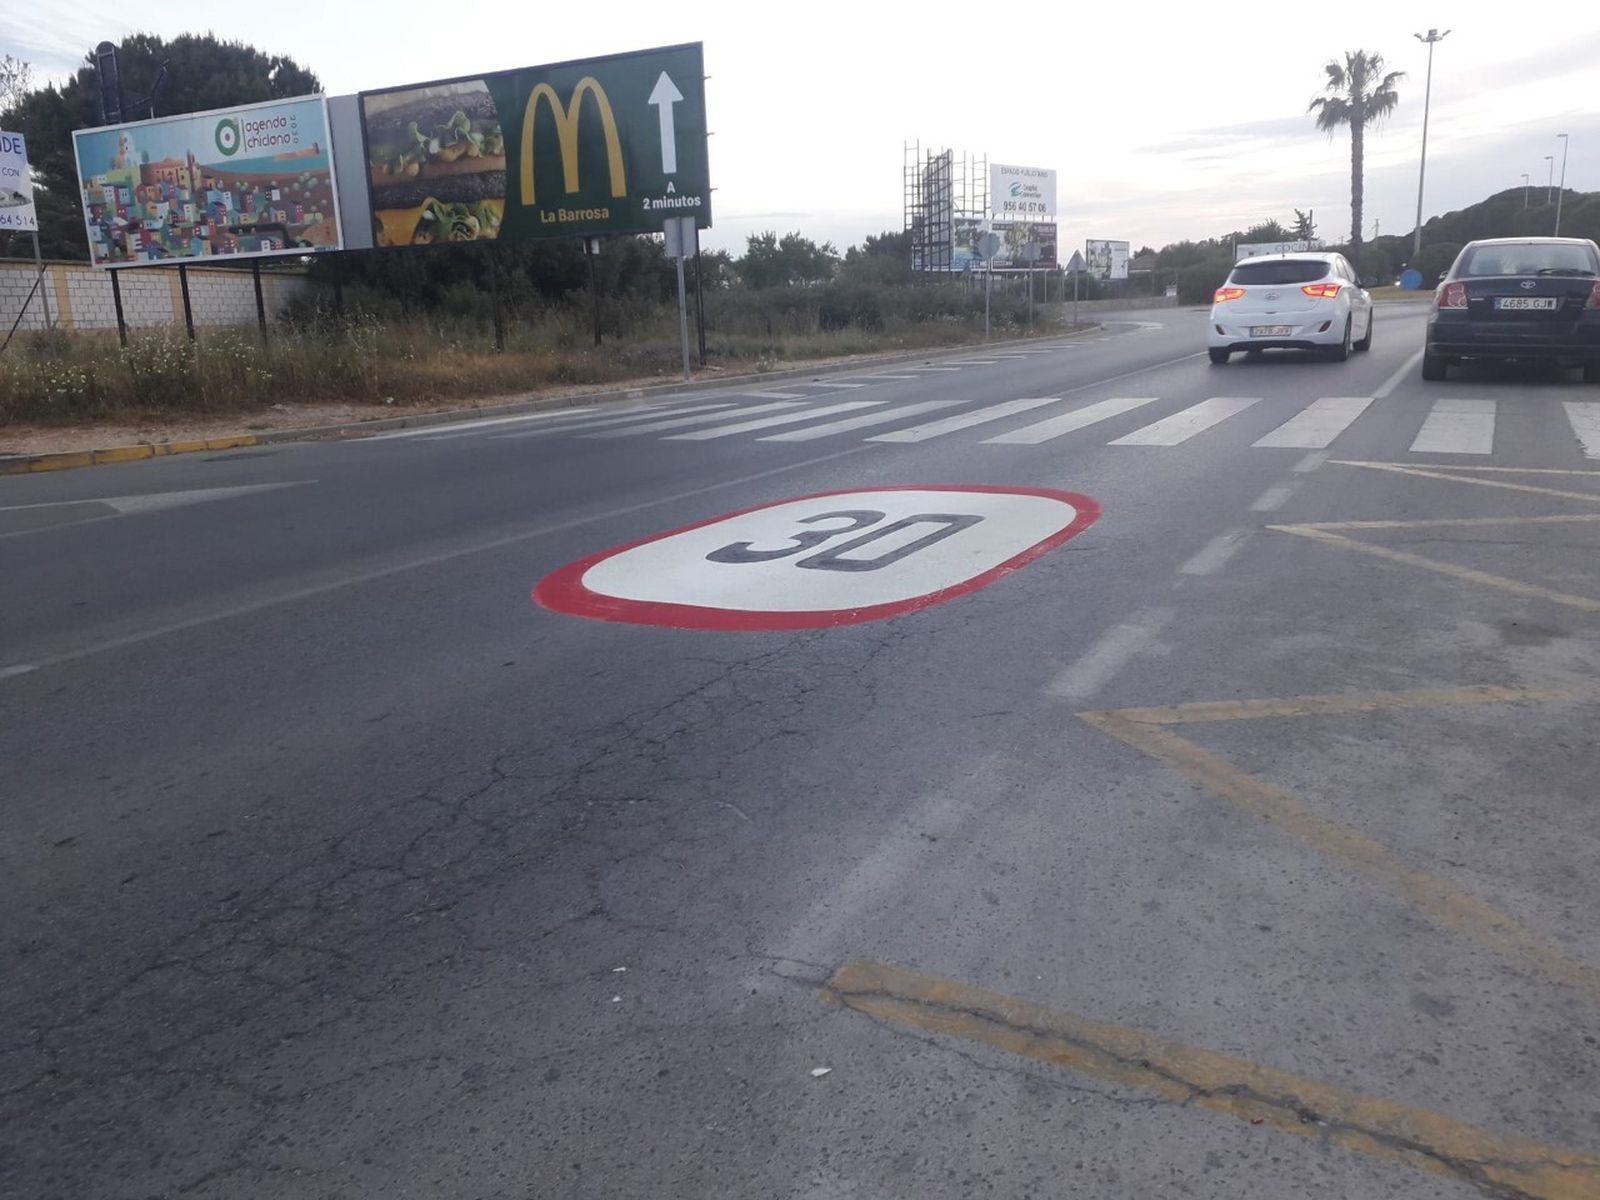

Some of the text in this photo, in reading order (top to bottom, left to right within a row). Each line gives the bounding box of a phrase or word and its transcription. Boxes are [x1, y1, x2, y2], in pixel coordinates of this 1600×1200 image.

[666, 181, 676, 193] A
[642, 195, 702, 210] 2 minutos
[1003, 201, 1017, 211] 956
[15, 215, 35, 226] 514
[540, 207, 610, 223] La Barrosa
[1503, 299, 1529, 308] 4685
[705, 510, 983, 571] 30
